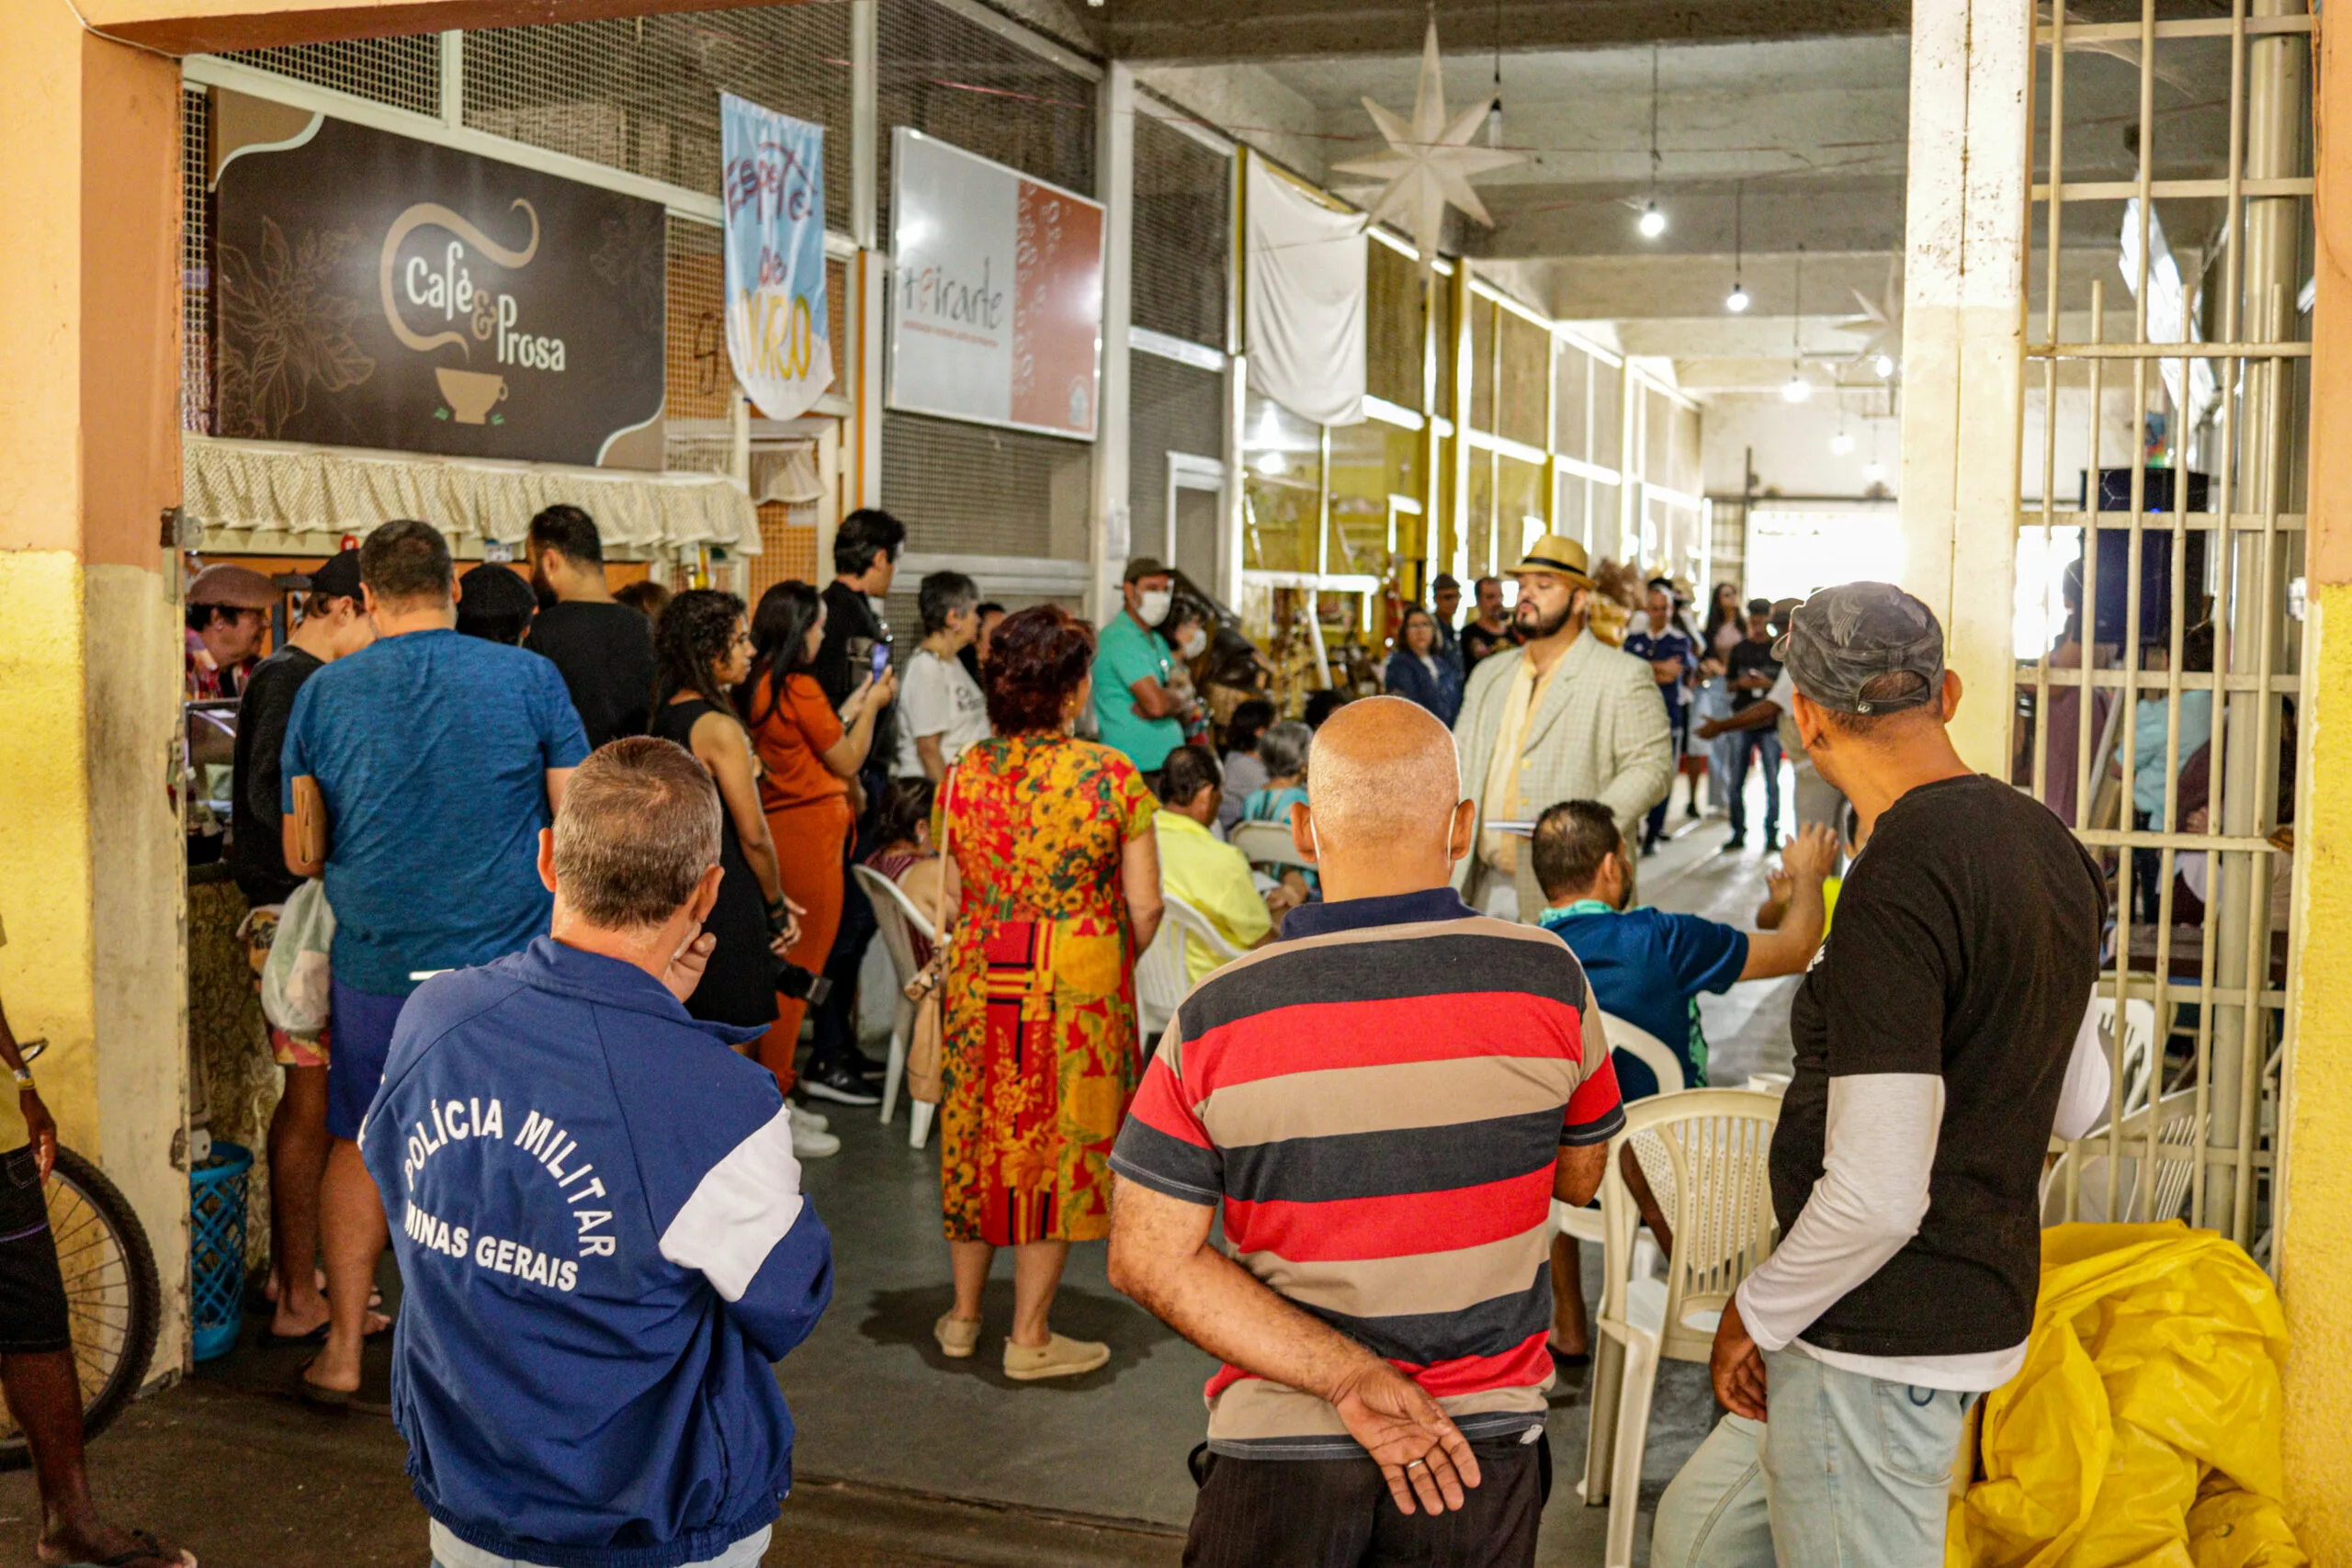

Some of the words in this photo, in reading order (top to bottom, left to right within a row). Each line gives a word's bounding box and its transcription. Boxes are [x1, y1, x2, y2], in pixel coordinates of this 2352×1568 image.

[406, 241, 473, 321] Café
[471, 289, 498, 341] &
[497, 294, 566, 372] Prosa
[404, 1097, 503, 1192] POLÍCIA
[514, 1110, 616, 1258] MILITAR
[404, 1199, 469, 1258] MINAS
[475, 1235, 579, 1292] GERAIS
